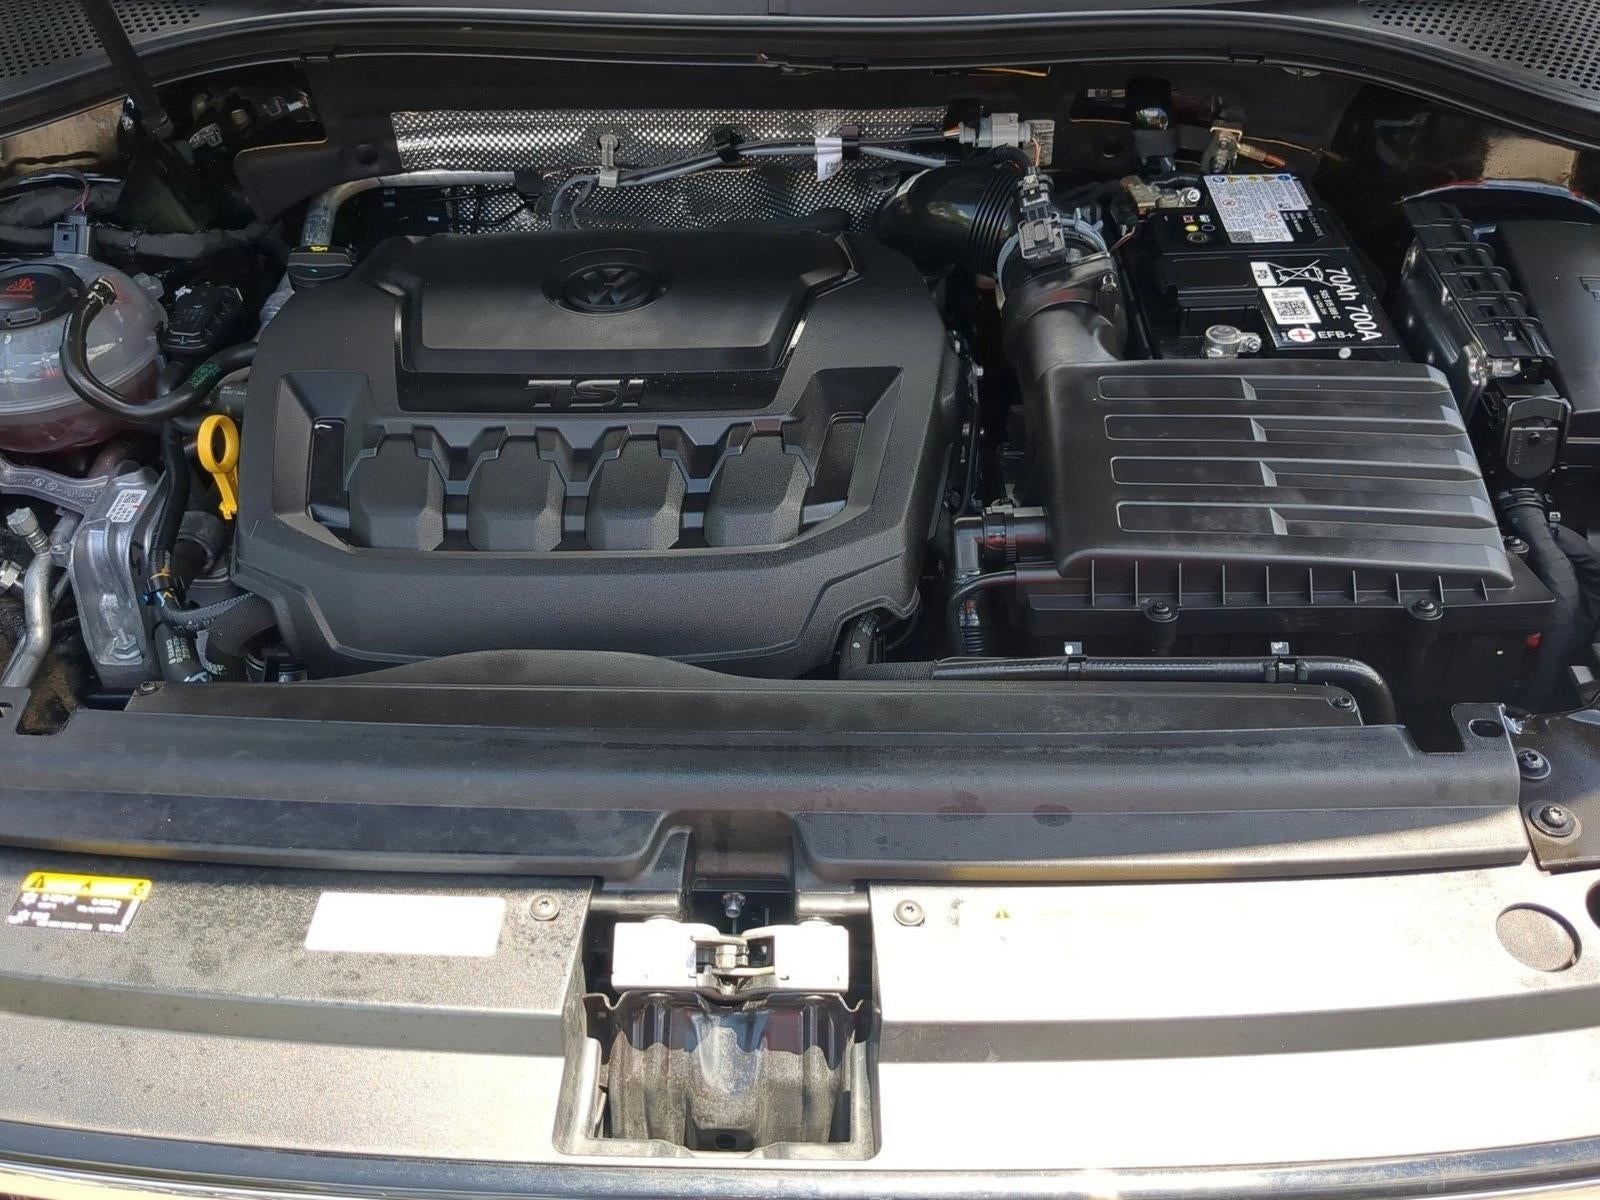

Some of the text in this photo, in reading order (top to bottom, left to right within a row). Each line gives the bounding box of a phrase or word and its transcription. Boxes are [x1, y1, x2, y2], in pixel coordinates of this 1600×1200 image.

[1257, 269, 1269, 280] Pb
[1325, 267, 1382, 341] 70Ah 700A
[1317, 330, 1355, 340] EFB+
[525, 378, 647, 408] TSI
